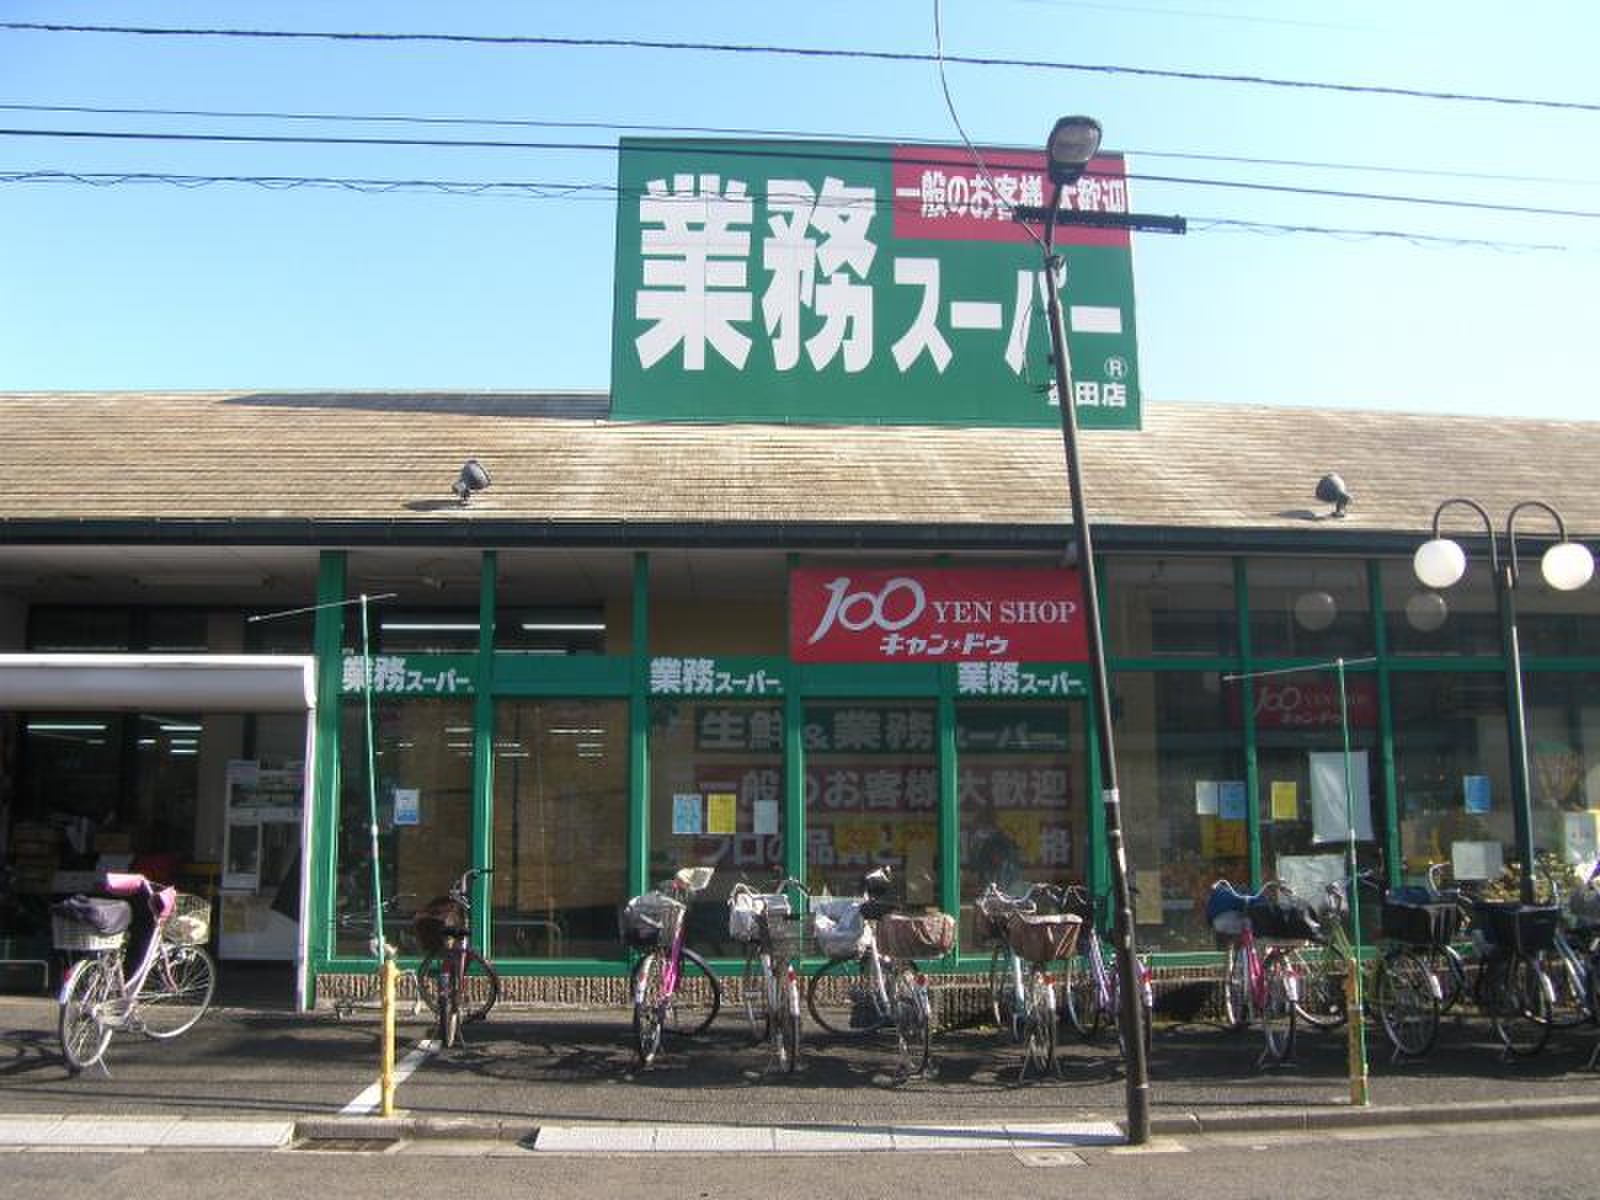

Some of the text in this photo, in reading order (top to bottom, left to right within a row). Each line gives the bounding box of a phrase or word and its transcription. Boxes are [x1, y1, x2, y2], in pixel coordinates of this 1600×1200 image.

[808, 577, 1077, 645] 100 YEN SHOP
[342, 656, 471, 693] 業務スーパー
[650, 657, 781, 693] 業務スーパー
[957, 661, 1083, 694] 業務スーパー
[701, 710, 1066, 751] 生鮮&業務ーパー
